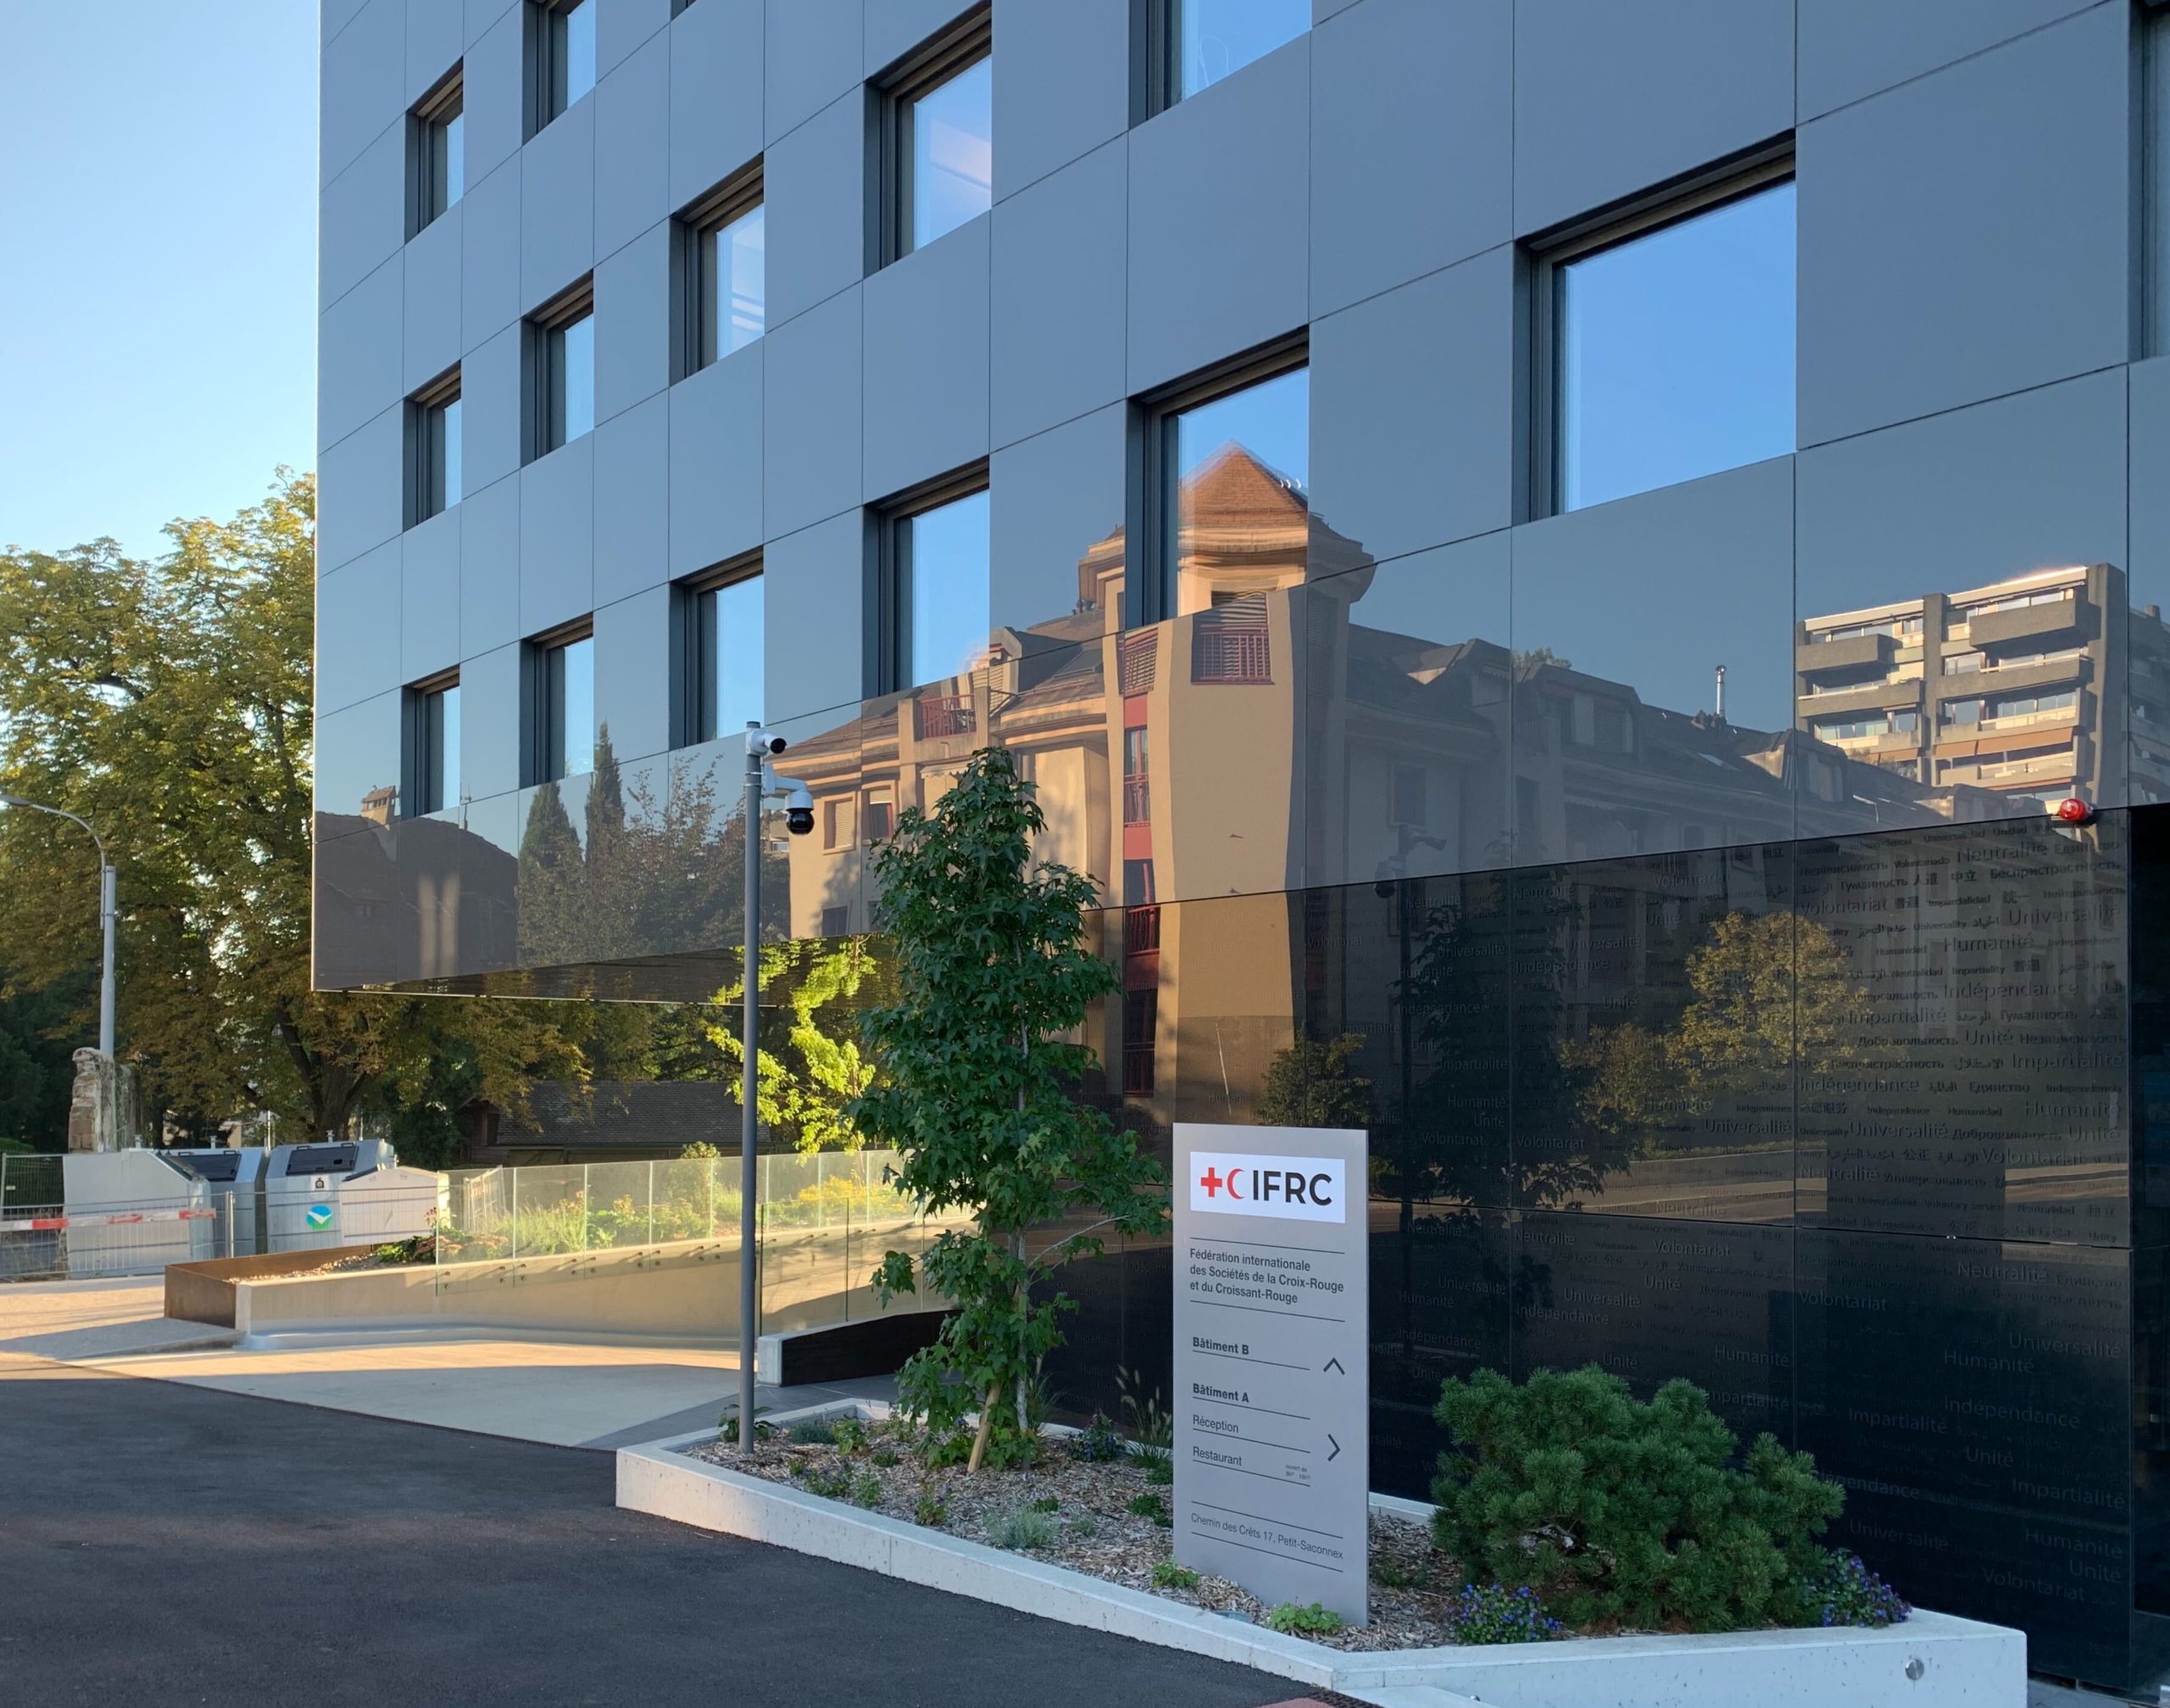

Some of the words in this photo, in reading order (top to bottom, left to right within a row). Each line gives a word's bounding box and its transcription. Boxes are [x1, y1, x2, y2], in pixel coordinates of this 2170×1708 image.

[1957, 841, 2047, 863] Neutralité
[1951, 869, 1978, 882] 中立
[1513, 885, 1575, 900] Neutralité
[1800, 899, 1888, 916] Volontariat
[2009, 906, 2122, 926] Universalité
[1645, 912, 1682, 926] Unité
[1564, 934, 1642, 950] Universalité
[1944, 932, 2034, 953] Humanité
[1516, 959, 1610, 974] Indépendance
[1603, 994, 1639, 1009] Unité
[1944, 982, 2078, 1002] Indépendance
[1849, 1007, 1946, 1026] Impartialité
[1966, 1030, 2013, 1046] Unité
[2011, 1052, 2124, 1072] Impartialité
[1800, 1077, 1919, 1093] Indépendance
[1448, 1094, 1505, 1109] Humanité
[1948, 1107, 2002, 1116] Humanidad
[2024, 1101, 2121, 1117] Humanité
[1474, 1114, 1505, 1127] Unité
[1705, 1119, 1791, 1134] Universalité
[1849, 1121, 1948, 1139] Universalité
[1422, 1132, 1484, 1146] Volontariat
[1517, 1134, 1585, 1149] Volontariat
[2067, 1125, 2120, 1142] Unité
[1980, 1147, 2082, 1164] Volontariat
[1800, 1166, 1879, 1182] Neutralité
[1253, 1170, 1333, 1206] IFRC
[1515, 1229, 1575, 1245] Neutralité
[1654, 1240, 1731, 1257] Volontariat
[1190, 1248, 1239, 1263] Fédération
[1242, 1254, 1310, 1271] internationale
[1190, 1265, 1206, 1277] des
[1209, 1266, 1249, 1281] Sociétés
[1253, 1272, 1265, 1282] de
[1267, 1273, 1276, 1284] la
[1279, 1274, 1344, 1293] Croix-Rouge
[1957, 1262, 2047, 1282] Neutralité
[1190, 1282, 1199, 1290] et
[1202, 1282, 1213, 1293] du
[1216, 1283, 1298, 1304] Croissant-Rouge
[1644, 1275, 1683, 1293] Unité
[1564, 1288, 1642, 1309] Universalité
[1799, 1290, 1887, 1312] Volontariat
[1517, 1304, 1610, 1325] Indépendance
[1193, 1337, 1238, 1354] Bâtiment
[1242, 1345, 1249, 1355] B
[2009, 1332, 2123, 1358] Universalité
[1603, 1353, 1639, 1371] Unité
[1716, 1345, 1789, 1367] Humanité
[1944, 1349, 2035, 1374] Humanité
[1193, 1383, 1238, 1401] Bâtiment
[1242, 1393, 1249, 1403] A
[1711, 1388, 1789, 1411] mpartialité
[1849, 1405, 1947, 1434] Impartialité
[1945, 1395, 2080, 1428] Indépendance
[1193, 1415, 1238, 1433] Réception
[1193, 1446, 1242, 1466] Restaurant
[1966, 1446, 2014, 1468] Unité
[2011, 1477, 2125, 1509] Impartialité
[1191, 1513, 1221, 1528] Chemin
[1223, 1520, 1237, 1533] des
[1239, 1525, 1260, 1538] Crêts
[1264, 1531, 1275, 1544] 17,
[1278, 1535, 1344, 1560] Petit-Saconnex
[1850, 1518, 1949, 1549] Universalité
[2024, 1528, 2123, 1559] Humanité
[2068, 1559, 2122, 1583] Unité
[1981, 1566, 2085, 1602] Volontariat
